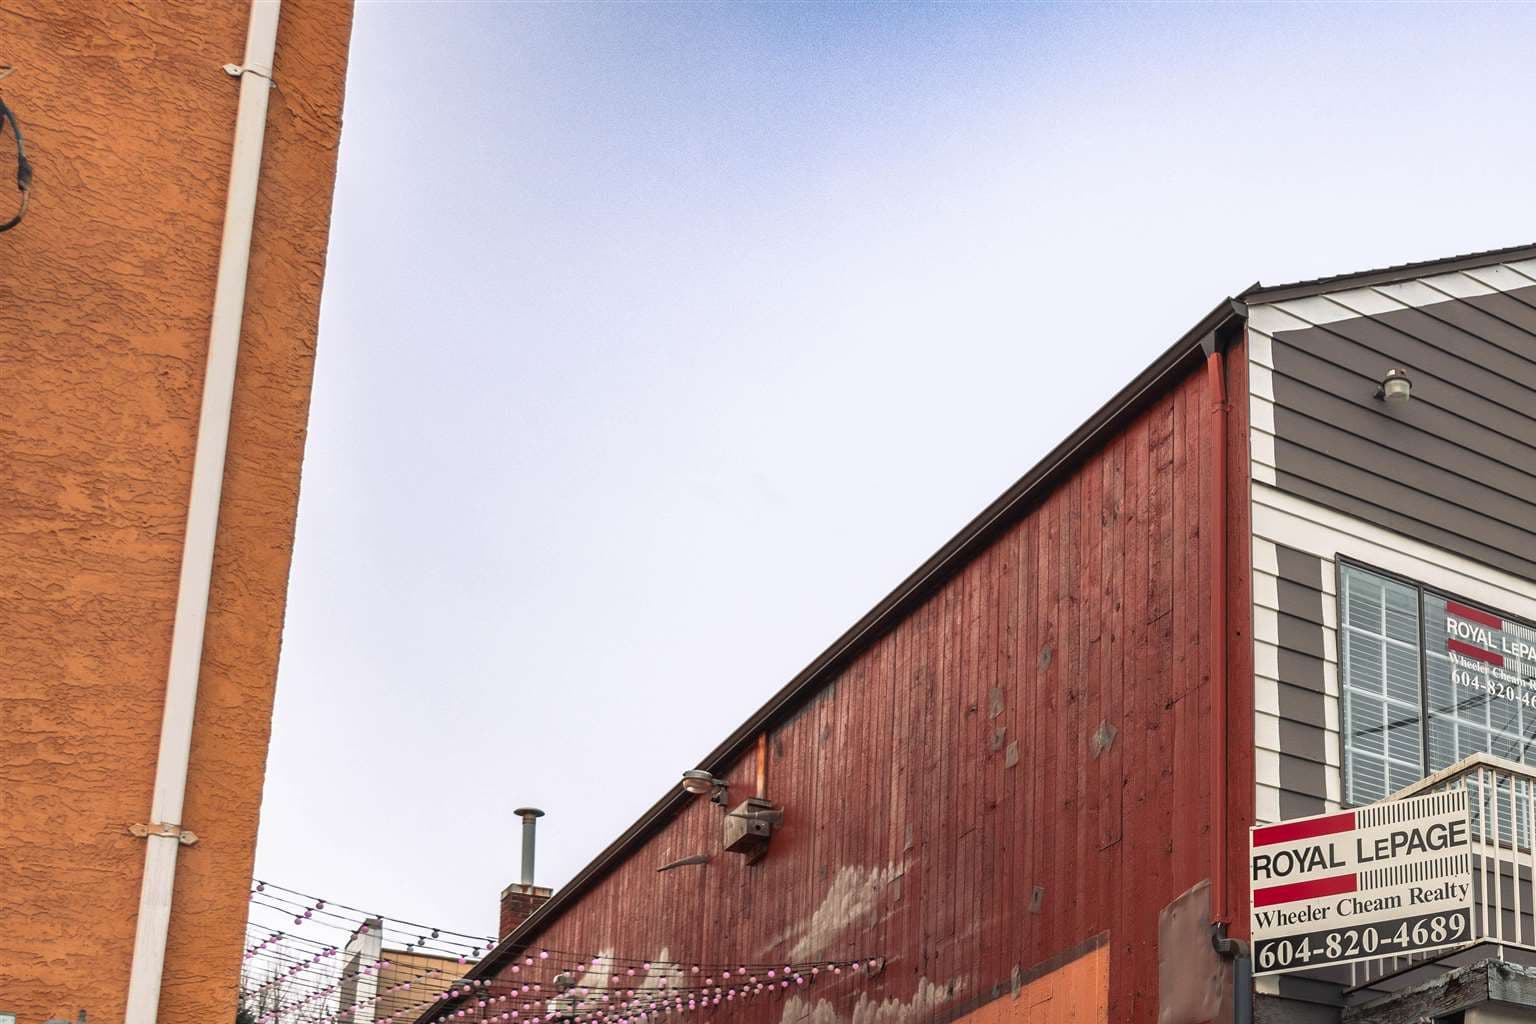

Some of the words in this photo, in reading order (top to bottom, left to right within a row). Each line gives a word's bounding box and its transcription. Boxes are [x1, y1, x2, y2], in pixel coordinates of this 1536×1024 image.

[1446, 617, 1498, 649] ROYAL
[1448, 652, 1489, 673] Wheeler
[1253, 843, 1346, 881] ROYAL
[1254, 906, 1331, 929] Wheeler
[1336, 895, 1402, 917] Cheam
[1409, 882, 1470, 905] Realty
[1259, 913, 1466, 969] 604-820-4689
